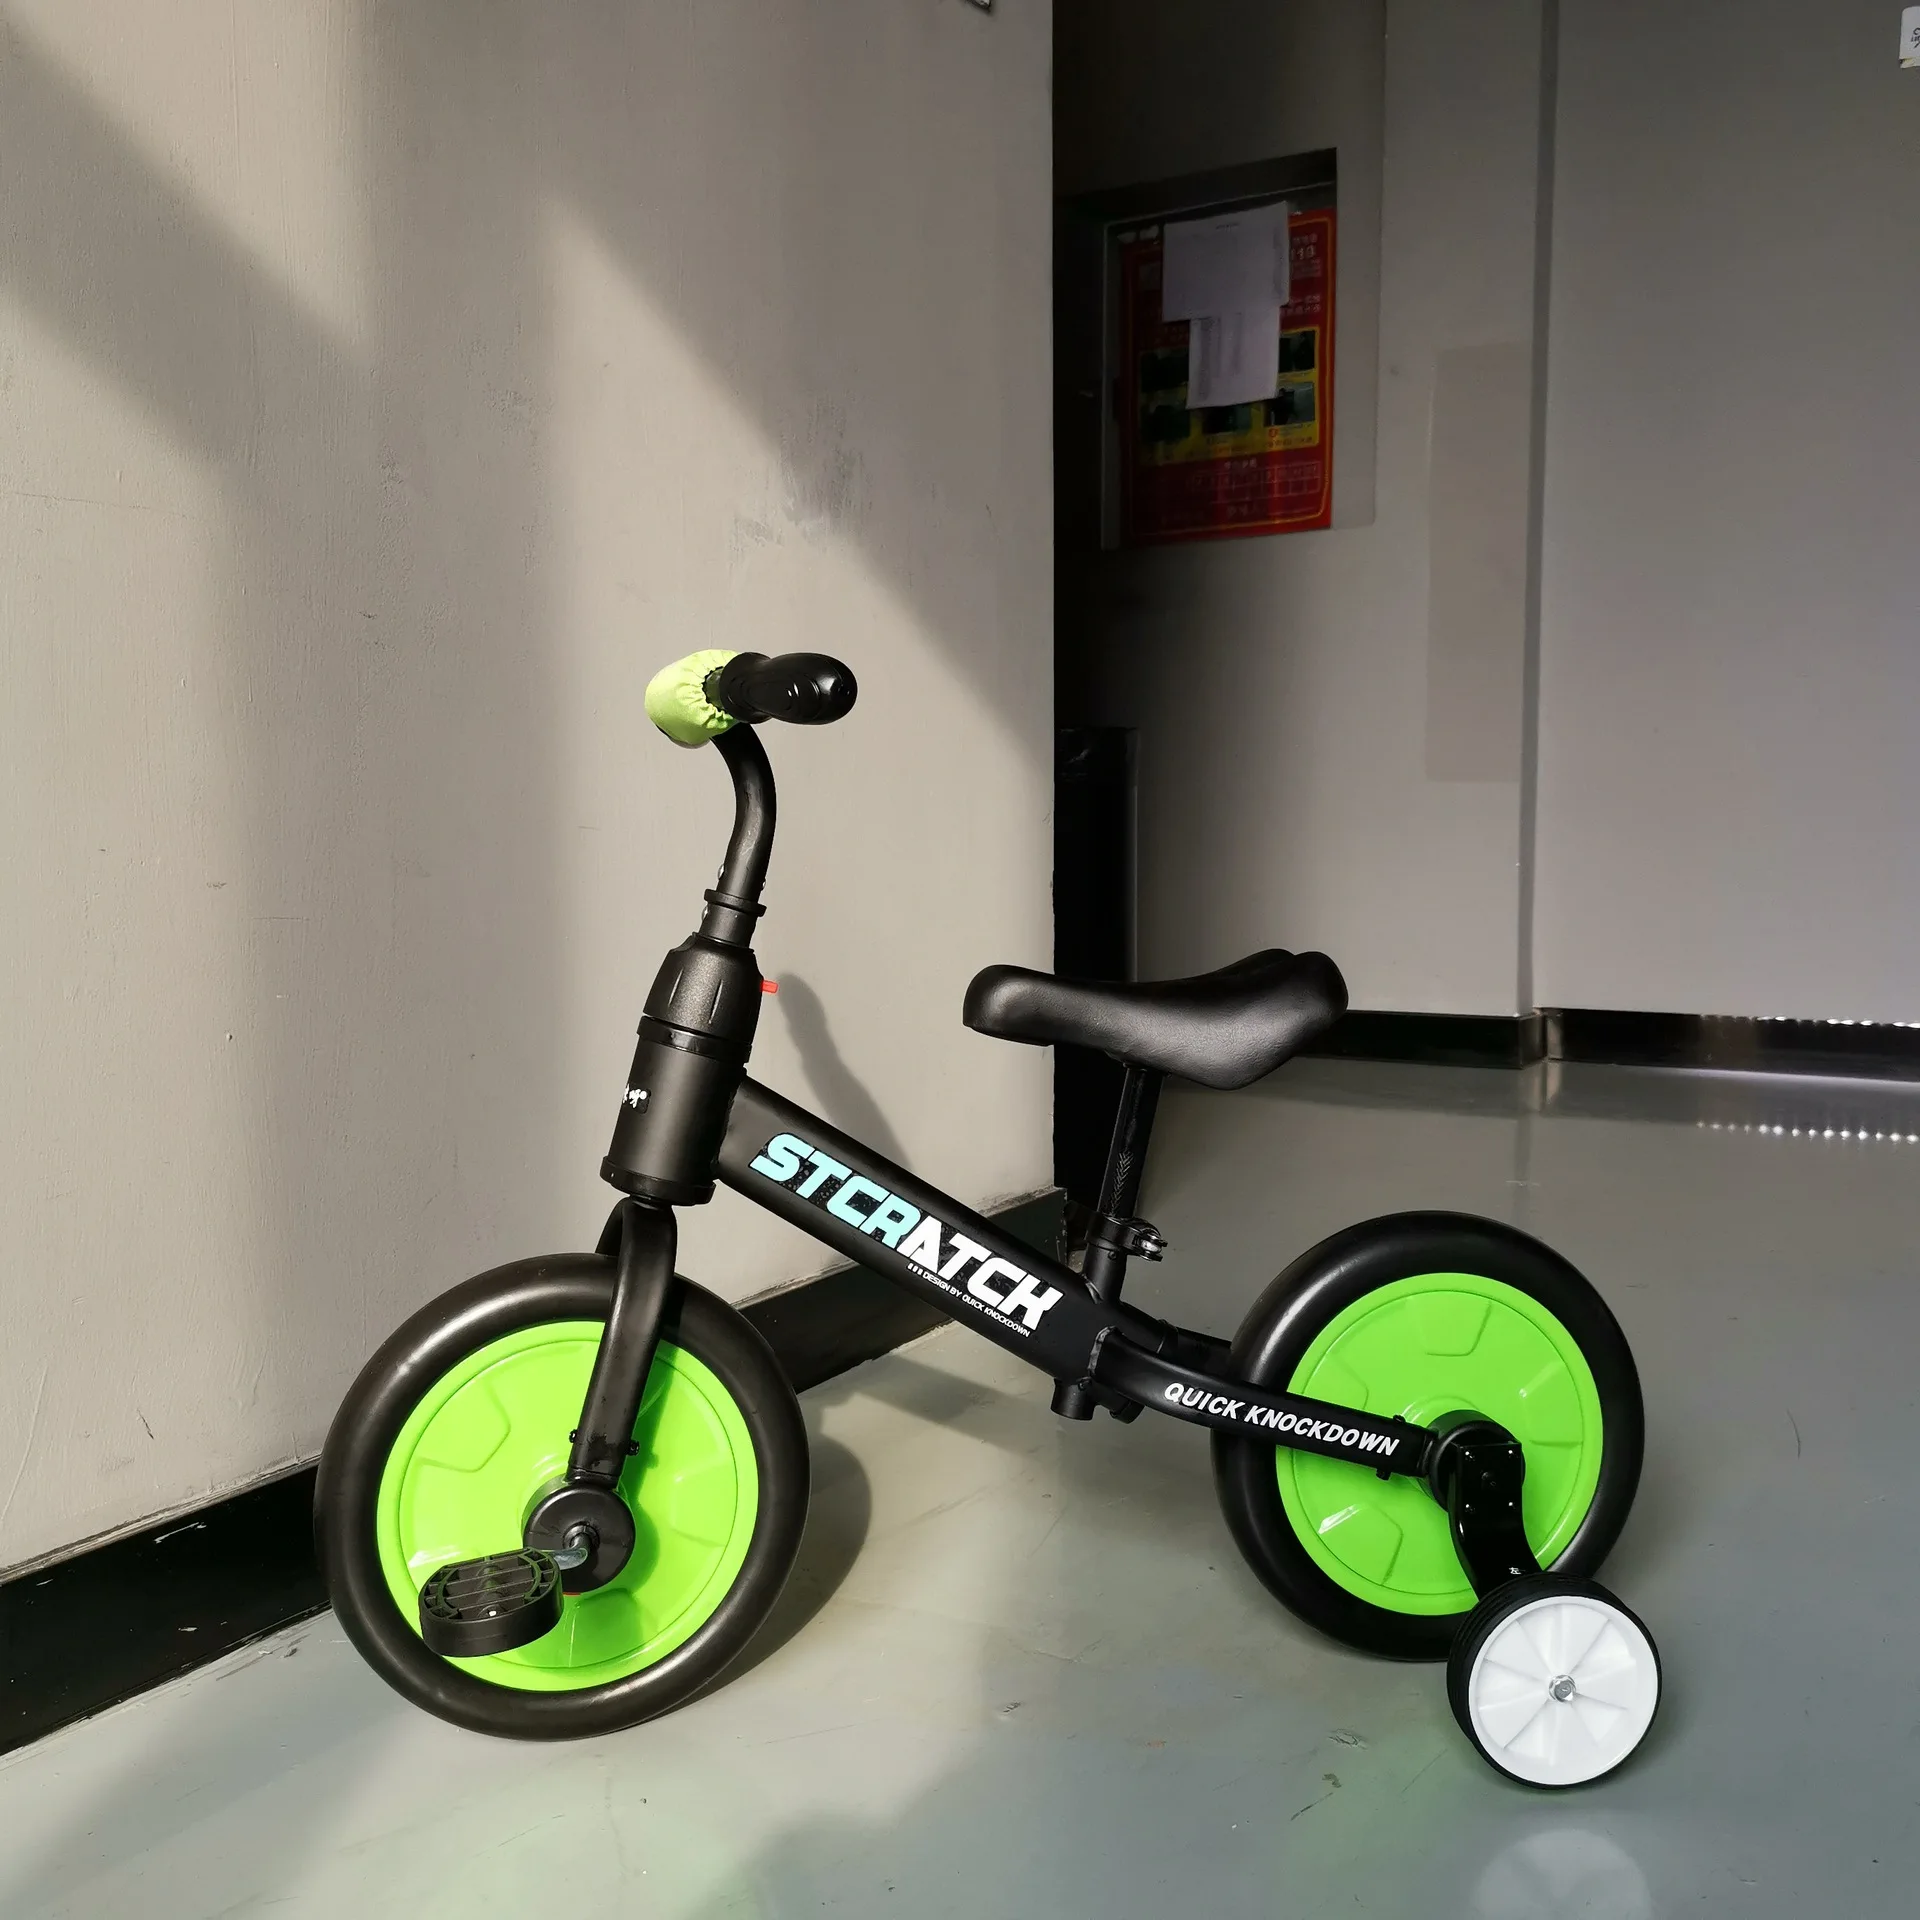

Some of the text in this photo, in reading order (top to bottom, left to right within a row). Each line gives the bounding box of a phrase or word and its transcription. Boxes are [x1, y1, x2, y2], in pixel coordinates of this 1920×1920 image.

[749, 1132, 1064, 1330] STCRATCH
[923, 1272, 1030, 1337] DESIGN BY QUICK KNOCKDOWN
[1164, 1383, 1400, 1456] QUICK KNOCKDOWN
